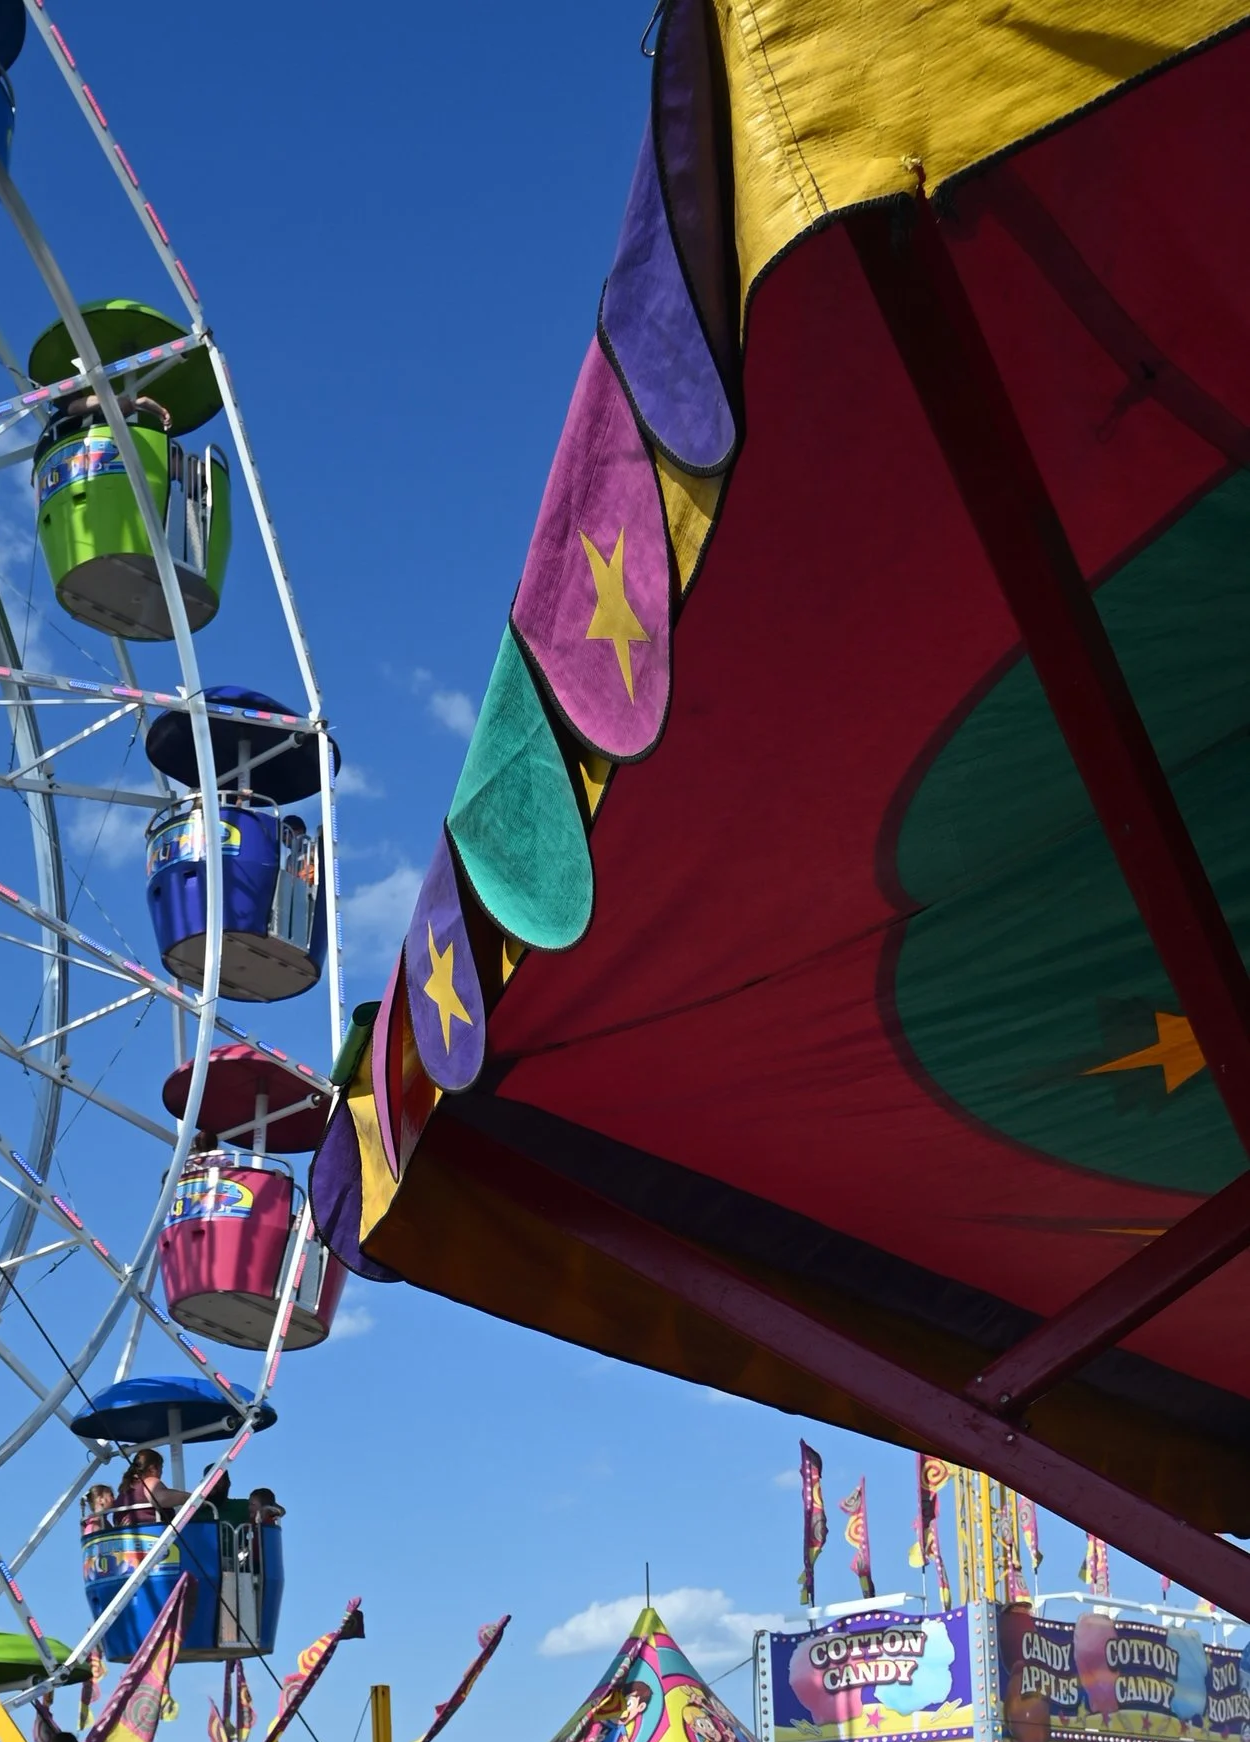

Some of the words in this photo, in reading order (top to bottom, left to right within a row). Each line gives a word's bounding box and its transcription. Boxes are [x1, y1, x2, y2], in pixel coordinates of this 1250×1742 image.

[810, 1629, 925, 1668] COTTON
[1022, 1632, 1072, 1672] CANDY
[1106, 1638, 1178, 1677] COTTON
[823, 1659, 917, 1692] CANDY
[1020, 1666, 1078, 1705] APPLES
[1115, 1676, 1174, 1709] CANDY
[1212, 1662, 1238, 1692] SNO
[1208, 1694, 1250, 1723] KONES
